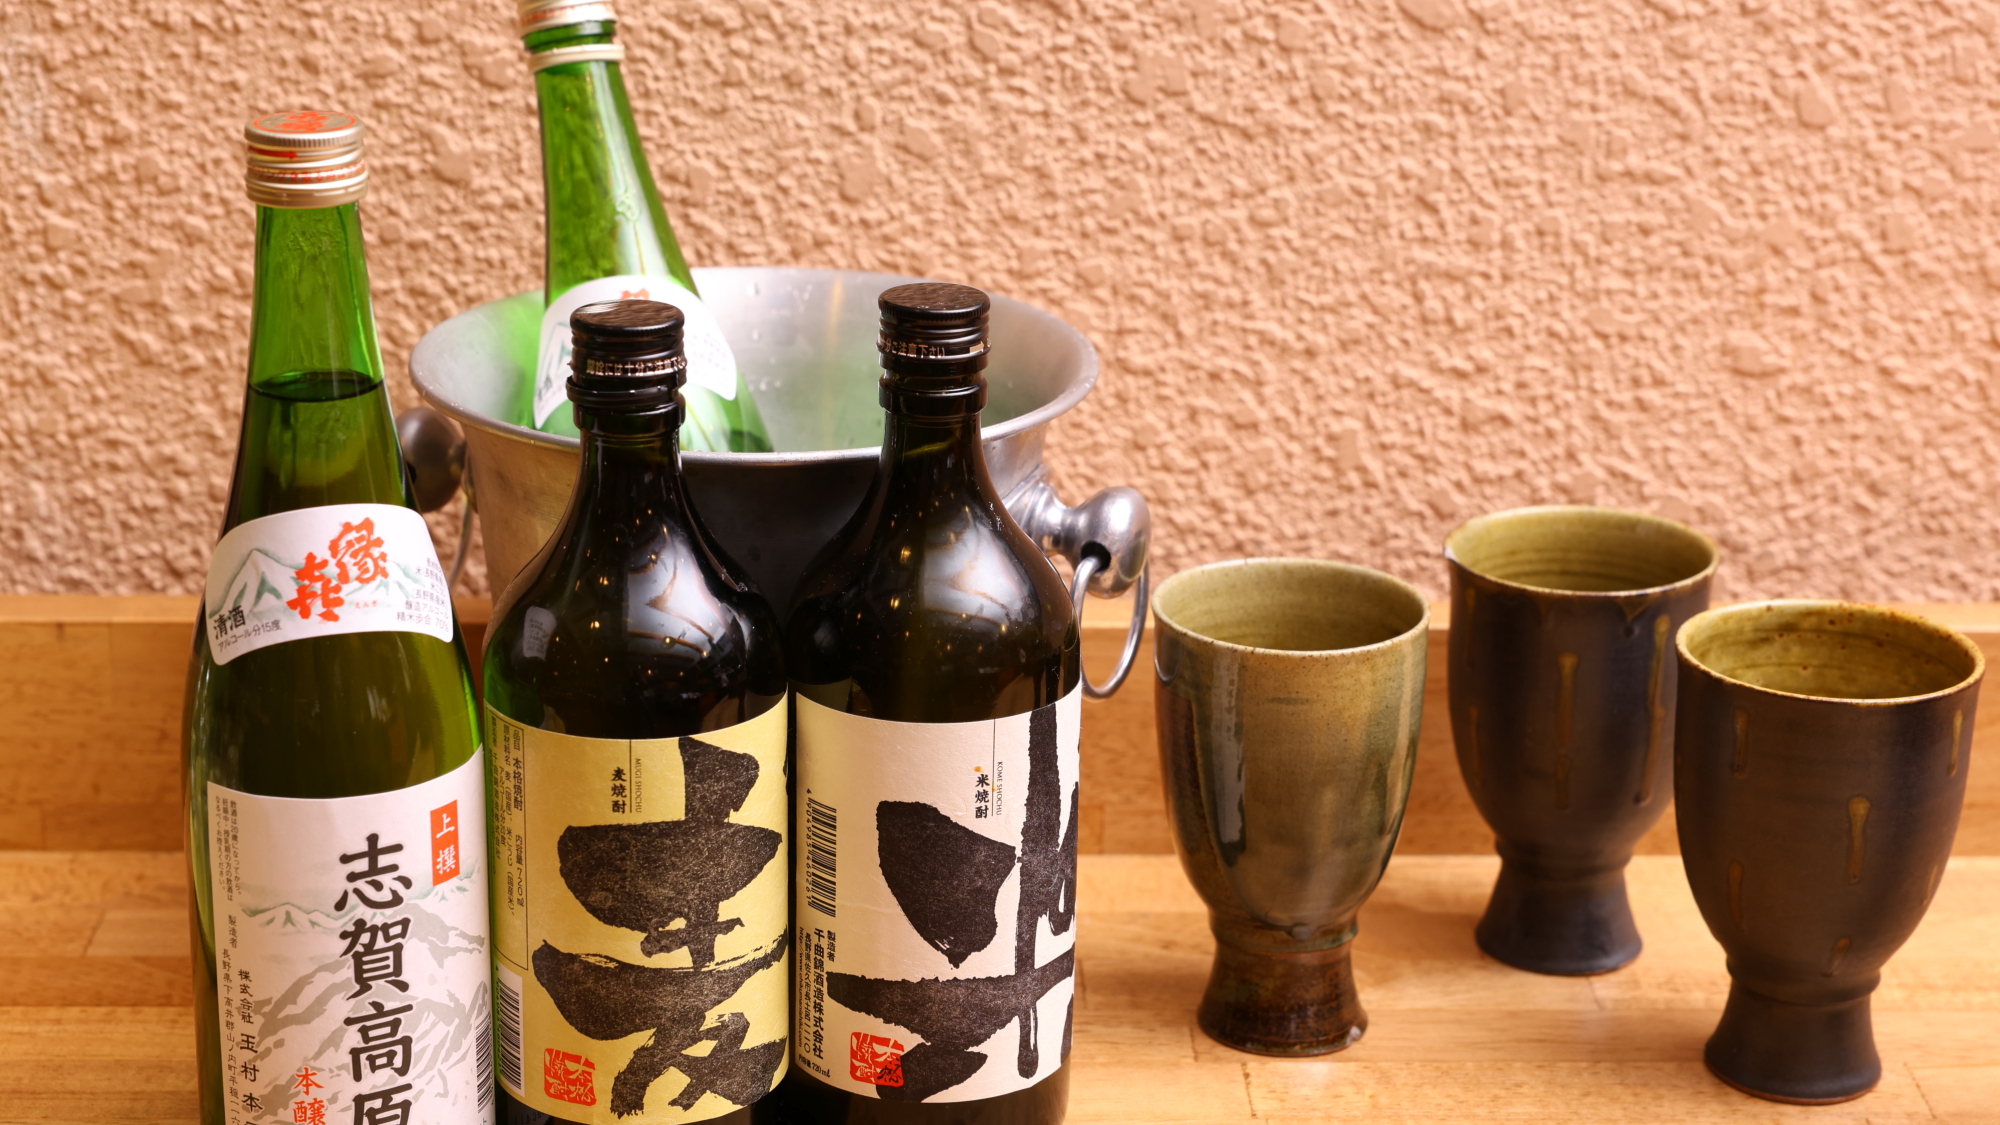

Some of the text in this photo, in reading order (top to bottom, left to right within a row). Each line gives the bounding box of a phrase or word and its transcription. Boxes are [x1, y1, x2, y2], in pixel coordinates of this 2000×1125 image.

[213, 605, 247, 640] 清酒
[217, 619, 283, 653] アルコール分15度
[634, 758, 642, 779] MUGI
[996, 761, 1004, 782] KOME
[611, 766, 628, 814] 麦焼酎
[974, 773, 990, 819] 米焼酎
[435, 813, 456, 875] 上撰
[228, 914, 238, 949] 製造者
[827, 930, 836, 963] 製造者
[334, 833, 413, 1125] 志賀高原
[813, 927, 825, 1060] 千曲錦酒造株式会社
[238, 968, 264, 1125] 株式会社 玉村本
